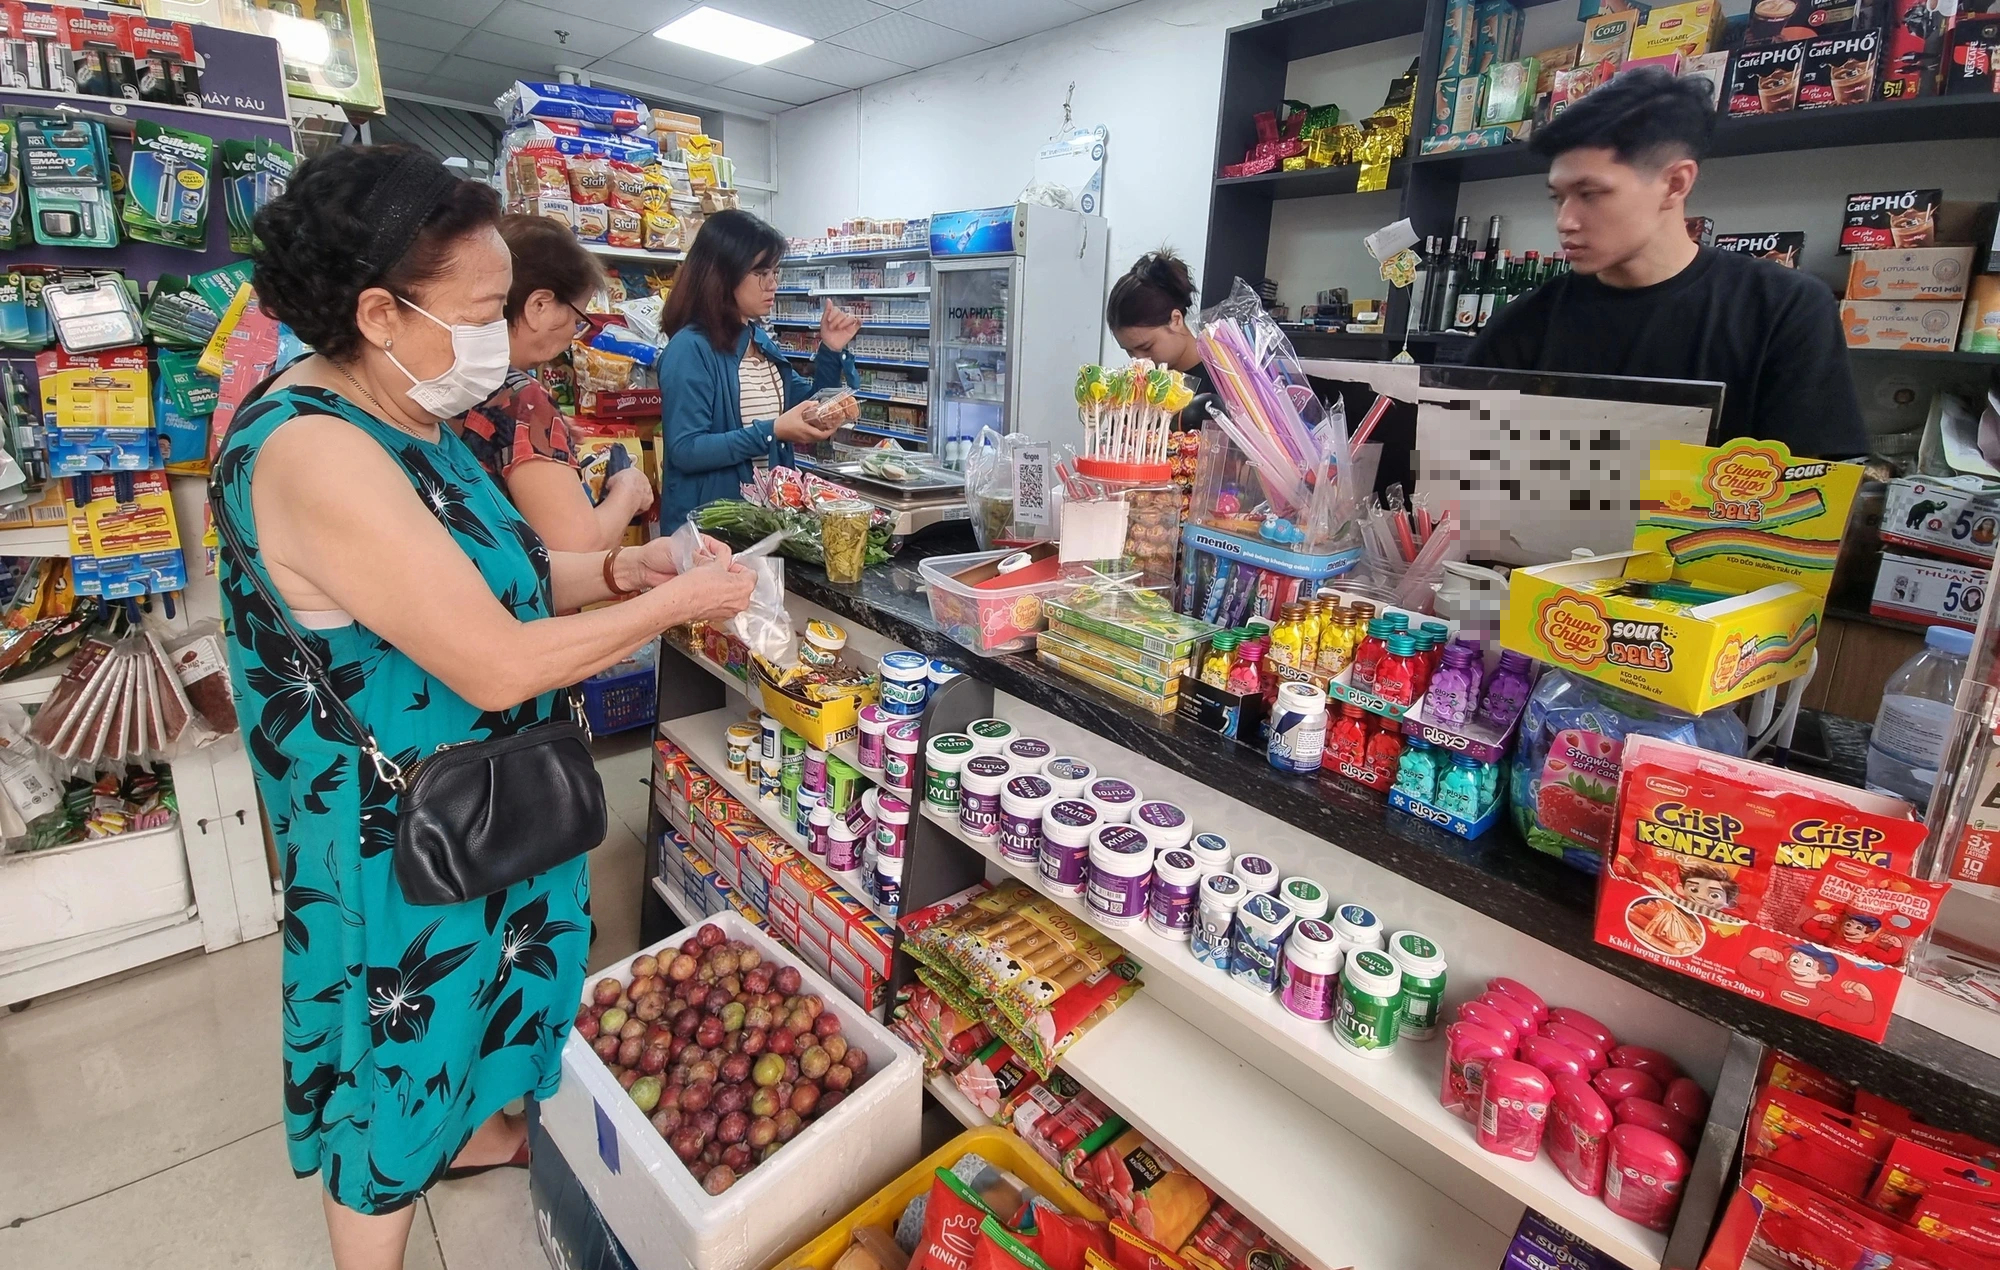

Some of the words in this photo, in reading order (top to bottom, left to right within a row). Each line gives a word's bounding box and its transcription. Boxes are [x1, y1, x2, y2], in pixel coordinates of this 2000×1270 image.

[70, 18, 115, 33] Gillette
[1596, 20, 1624, 38] Cozy
[1660, 20, 1681, 28] Lipton
[133, 28, 178, 42] Gillette
[134, 37, 159, 45] SUPER
[161, 40, 179, 48] THIN
[1647, 37, 1670, 46] YELLOW
[1670, 34, 1690, 42] LABEL
[1808, 47, 1832, 58] Café
[1832, 32, 1877, 54] PHỐ
[1738, 58, 1760, 68] Café
[1760, 42, 1803, 65] PHỐ
[137, 136, 208, 162] VECTOR
[158, 135, 207, 153] Gillette
[33, 158, 77, 167] MACH3
[582, 175, 606, 187] Staff
[620, 182, 644, 194] Staff
[544, 202, 568, 212] SANDWICH
[1847, 202, 1871, 212] Café
[1872, 190, 1915, 210] PHỐ
[579, 206, 602, 216] SANDWICH
[614, 218, 638, 231] Staff
[1737, 233, 1779, 252] PHỐ
[187, 388, 211, 396] Gillette
[1723, 462, 1772, 480] Chupa
[1784, 463, 1826, 481] SOUR
[133, 482, 162, 490] Gillette
[1717, 475, 1765, 496] Chups
[1712, 502, 1761, 522] BELT
[1196, 534, 1241, 553] mentos
[1326, 558, 1347, 572] mentos
[1553, 610, 1602, 634] Chupa
[1612, 621, 1660, 641] SOUR
[1549, 624, 1598, 651] Chups
[1615, 643, 1671, 670] BELT
[882, 683, 908, 703] Cool
[978, 722, 1004, 734] XYLITOL
[1219, 706, 1238, 739] 5
[936, 740, 970, 748] XYLITOL
[1013, 744, 1046, 752] XYLITOL
[972, 762, 1007, 770] XYLITOL
[1572, 760, 1594, 772] soft
[930, 786, 960, 801] XYLIT
[1018, 778, 1038, 798] XYLITOL
[1058, 804, 1092, 822] XYLITOL
[1746, 802, 1776, 814] DELICIOUS
[1754, 810, 1775, 818] CHEWY
[1654, 802, 1742, 842] Crisp
[1105, 830, 1138, 848] XYLITOL
[1790, 818, 1885, 850] Crisp
[1638, 820, 1750, 867] KONJAC
[1966, 846, 1990, 854] LONGER
[1170, 852, 1188, 868] XYLITOL
[1656, 850, 1692, 864] SPICY
[1963, 858, 1984, 872] 10
[1961, 868, 1979, 877] YEAR
[1823, 885, 1848, 898] CRAB
[1852, 893, 1896, 910] FLAVORED
[1900, 906, 1926, 919] STICK
[1826, 876, 1928, 910] HAND-SHREDDED
[1049, 916, 1078, 942] GOLD
[1608, 934, 1631, 950] Khối
[1632, 944, 1660, 962] lượng
[1361, 954, 1391, 972] XYLITOL
[1820, 1122, 1864, 1148] RESEALABLE
[1911, 1128, 1954, 1146] RESEALABLE
[1144, 1156, 1160, 1176] NGON
[1808, 1206, 1854, 1235] RESEALABLE
[929, 1243, 958, 1268] KINH
[1536, 1234, 1590, 1270] sugus
